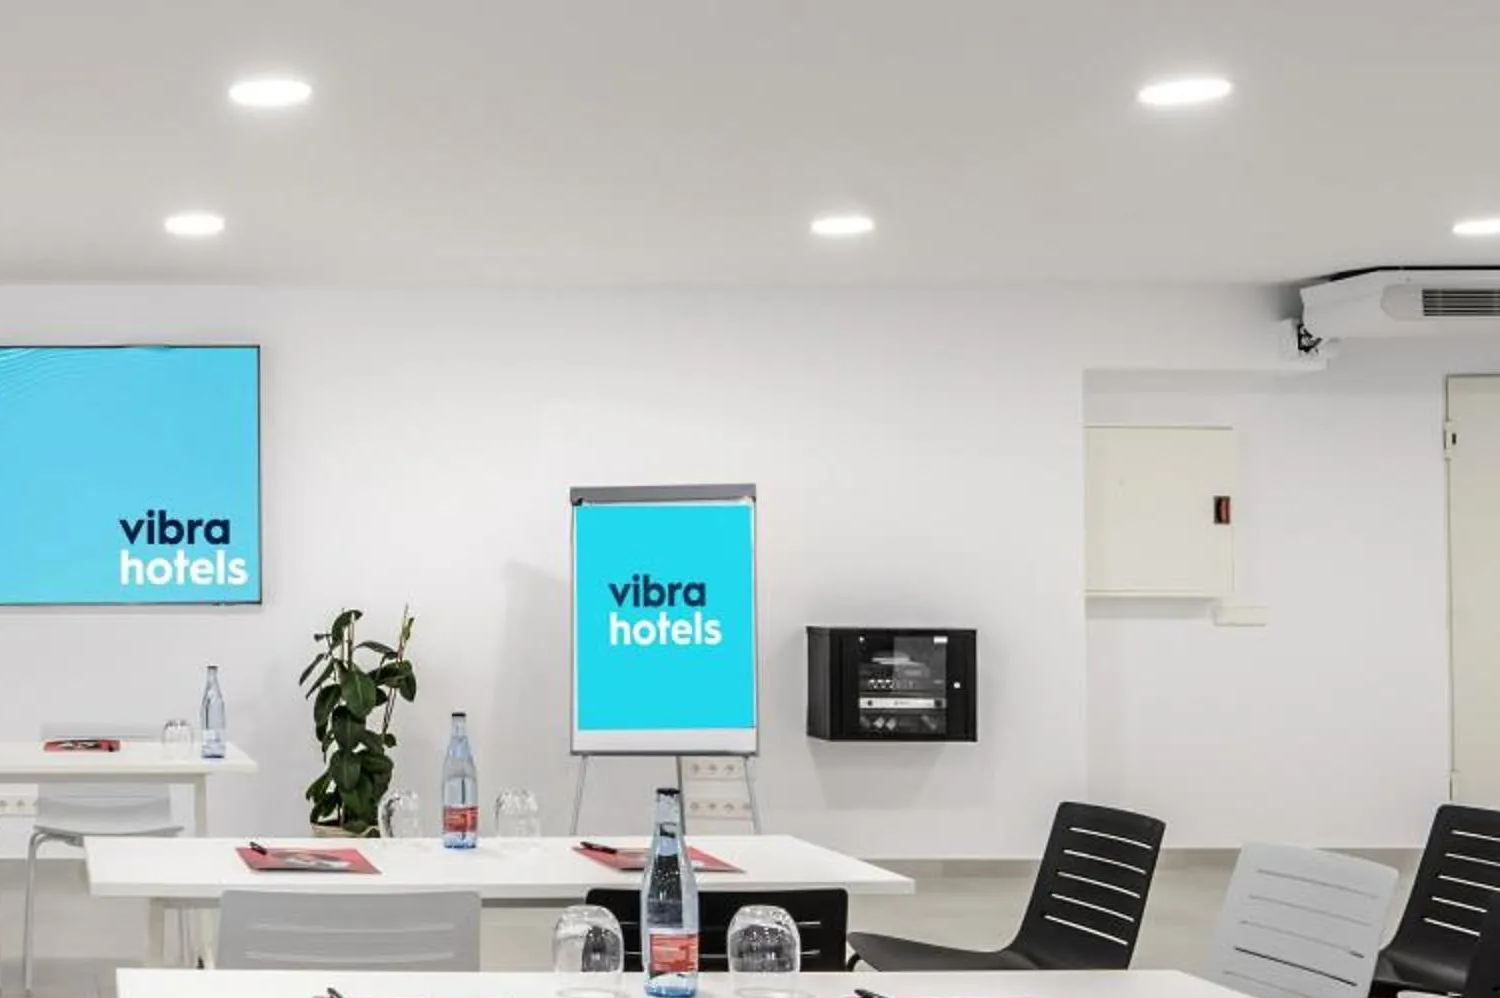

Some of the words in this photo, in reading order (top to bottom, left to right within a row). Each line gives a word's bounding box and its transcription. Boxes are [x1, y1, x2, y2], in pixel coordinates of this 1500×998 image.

[119, 509, 230, 545] vibra
[120, 549, 248, 585] hotels
[608, 573, 706, 608] vibra
[609, 611, 722, 646] hotels
